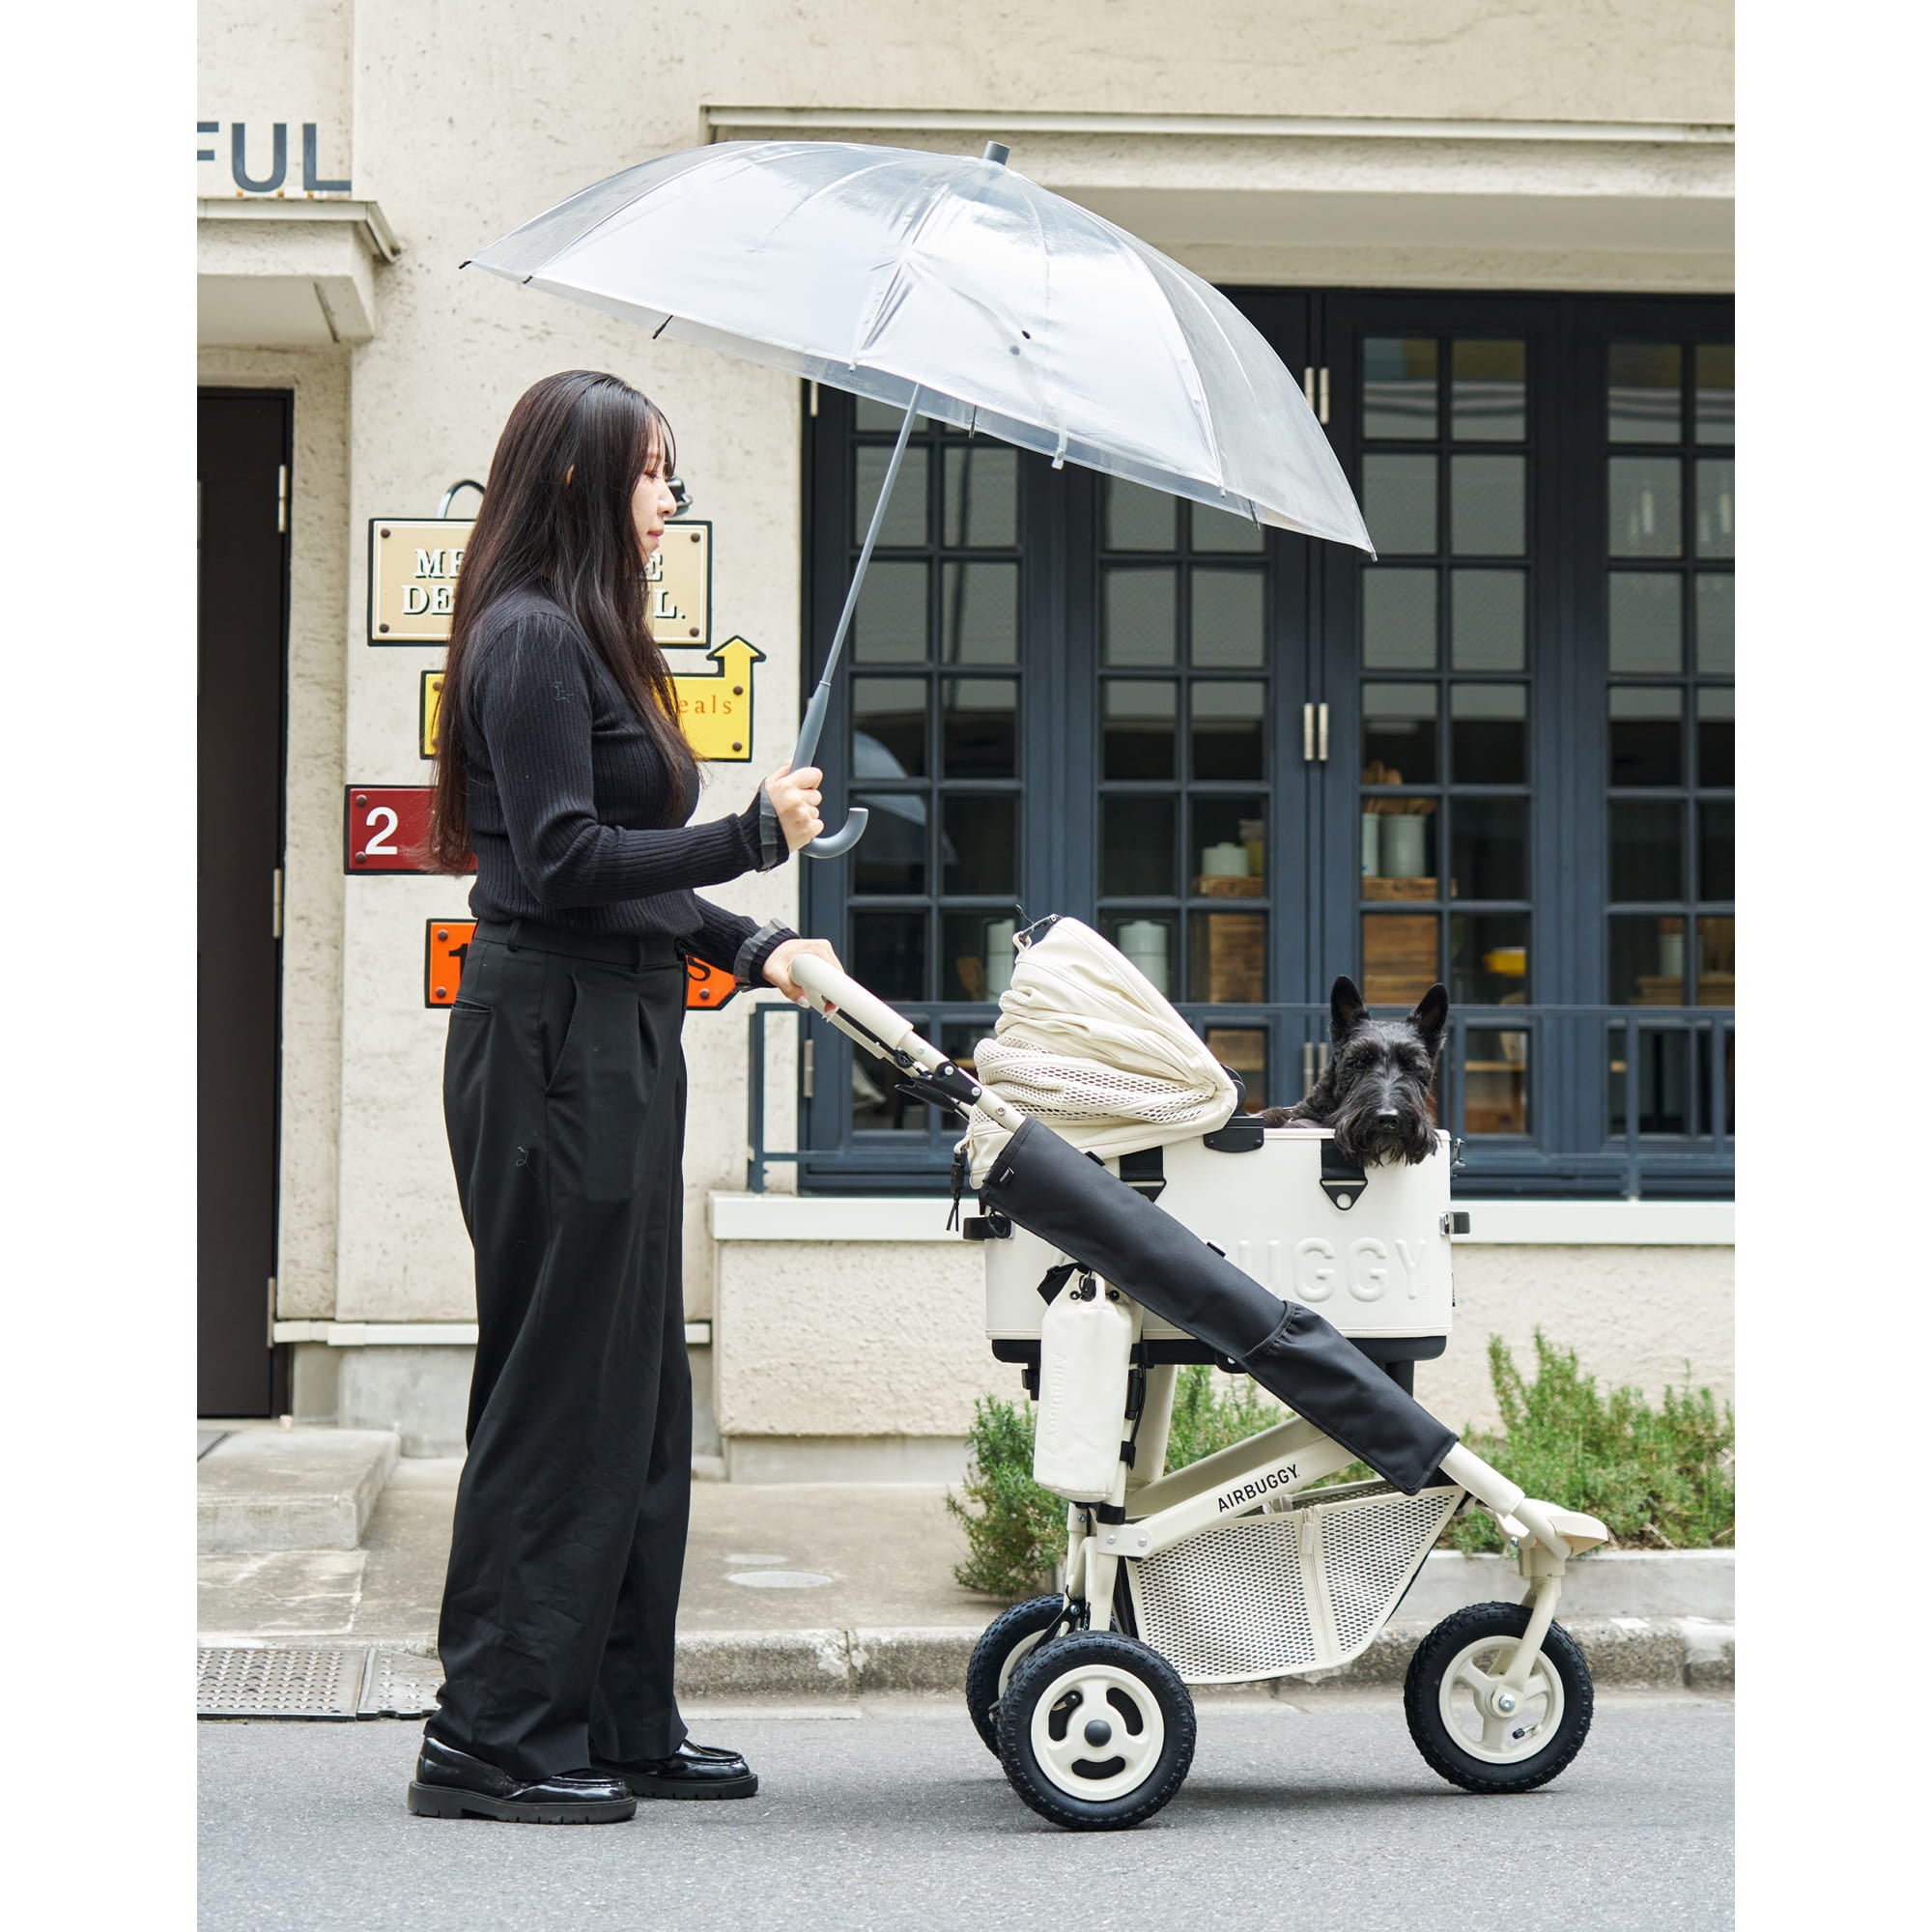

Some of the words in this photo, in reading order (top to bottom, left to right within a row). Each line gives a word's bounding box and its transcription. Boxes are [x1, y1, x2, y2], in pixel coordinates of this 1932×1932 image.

[412, 548, 466, 579] ME
[401, 584, 455, 615] DE
[652, 588, 686, 619] L.
[677, 695, 732, 715] eals
[365, 806, 399, 855] 2
[1211, 1236, 1428, 1303] UGGY
[1218, 1463, 1298, 1513] AIRBUGGY
